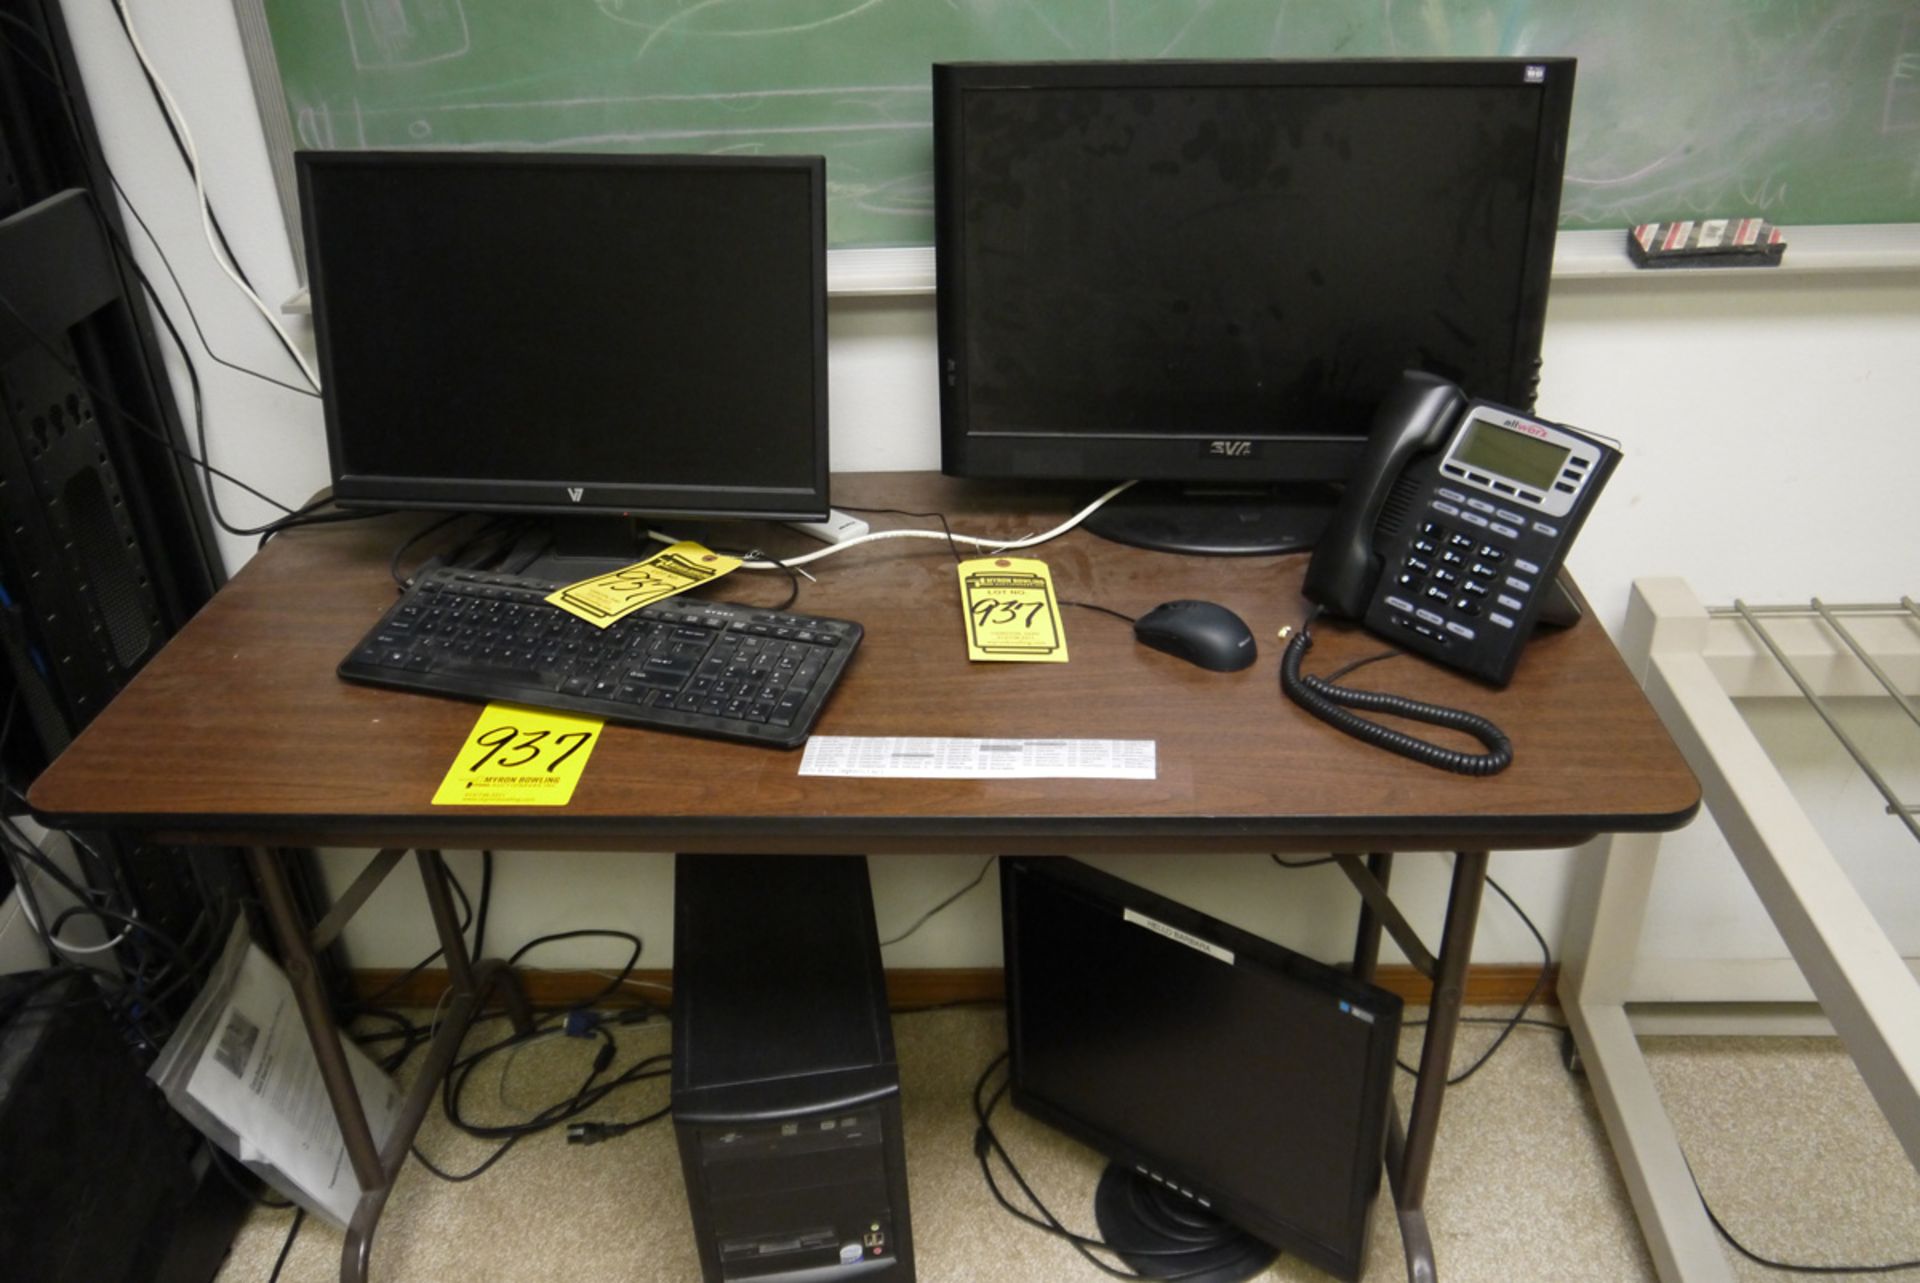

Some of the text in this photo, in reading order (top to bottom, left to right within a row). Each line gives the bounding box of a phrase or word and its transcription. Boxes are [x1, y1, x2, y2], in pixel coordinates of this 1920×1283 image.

[1503, 418, 1548, 439] allworx
[567, 487, 584, 503] V7
[971, 598, 1044, 628] 937
[469, 726, 593, 772] 937
[484, 776, 560, 784] MYRON BOWLING
